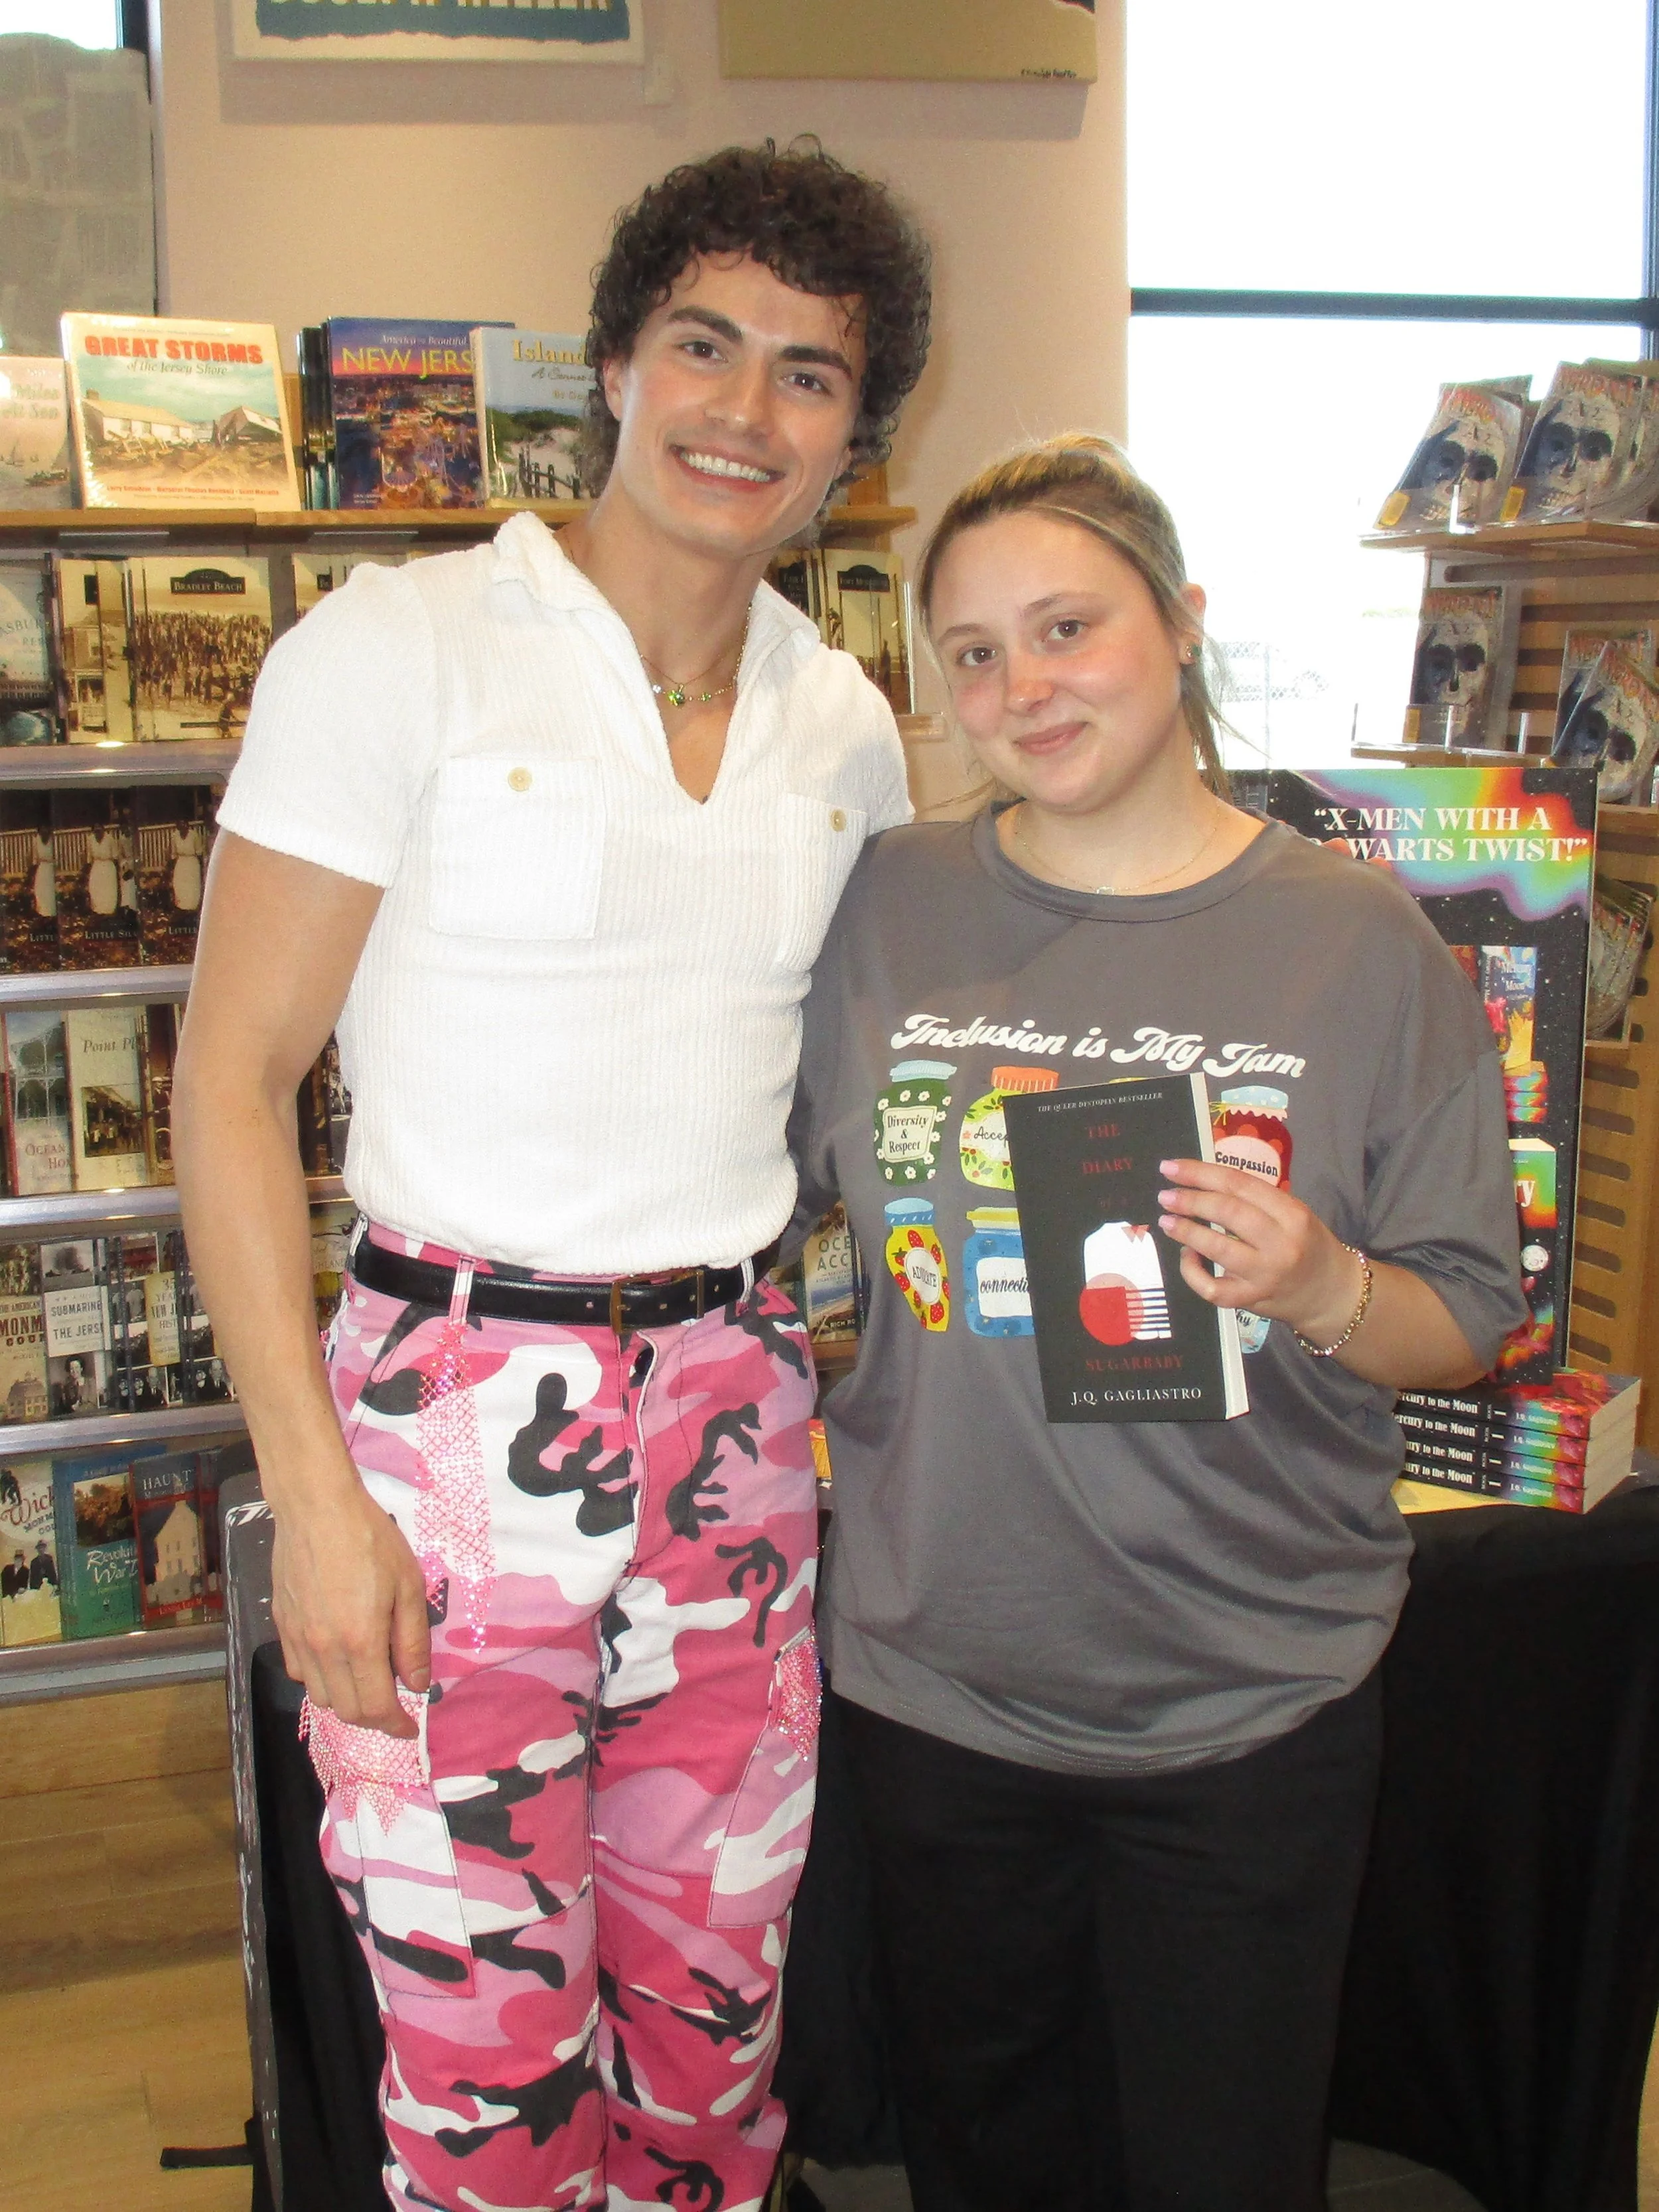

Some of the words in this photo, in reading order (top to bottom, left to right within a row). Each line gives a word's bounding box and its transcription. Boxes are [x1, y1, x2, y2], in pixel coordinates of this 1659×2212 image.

[85, 335, 160, 358] GREAT
[165, 340, 263, 364] STORMS
[127, 360, 136, 372] of
[136, 360, 157, 373] the
[161, 361, 193, 376] Jersey
[196, 364, 228, 376] Shore
[341, 347, 412, 373] NEW
[174, 583, 211, 592] BRADLEY
[214, 583, 242, 592] BEACH
[1315, 807, 1427, 831] “X-MEN
[1434, 807, 1521, 831] WITH
[1527, 807, 1553, 831] A
[1463, 837, 1589, 863] TWIST!”
[85, 931, 115, 940] LITTLE
[84, 1039, 116, 1054] Point
[891, 1014, 1068, 1056] Inclusion
[1072, 1026, 1109, 1058] is
[1110, 1026, 1206, 1072] My
[1202, 1042, 1307, 1079] Jam
[1054, 1102, 1076, 1113] QUEER
[1078, 1097, 1117, 1109] DYSTOPIAN
[1118, 1092, 1163, 1104] BESTSELLER
[887, 1115, 929, 1129] Diversity
[1084, 1123, 1121, 1139] THE
[901, 1129, 908, 1139] &
[889, 1140, 921, 1155] Respect
[1082, 1158, 1133, 1174] DIARY
[1214, 1151, 1279, 1177] Compassion
[53, 1326, 72, 1340] THE
[1086, 1355, 1184, 1371] SUGARBABY
[1070, 1391, 1098, 1406] J.Q.
[1104, 1387, 1202, 1401] GAGLIASTRO
[1427, 1396, 1436, 1406] to
[1437, 1399, 1451, 1409] the
[1453, 1399, 1479, 1414] Moon
[1425, 1419, 1433, 1429] to
[1435, 1420, 1448, 1432] the
[1450, 1422, 1476, 1438] Moon
[1423, 1443, 1431, 1454] to
[1432, 1446, 1446, 1457] the
[1447, 1446, 1474, 1463] Moon
[1422, 1465, 1431, 1476] to
[1431, 1468, 1445, 1479] the
[1447, 1468, 1473, 1485] Moon
[94, 1560, 125, 1584] War
